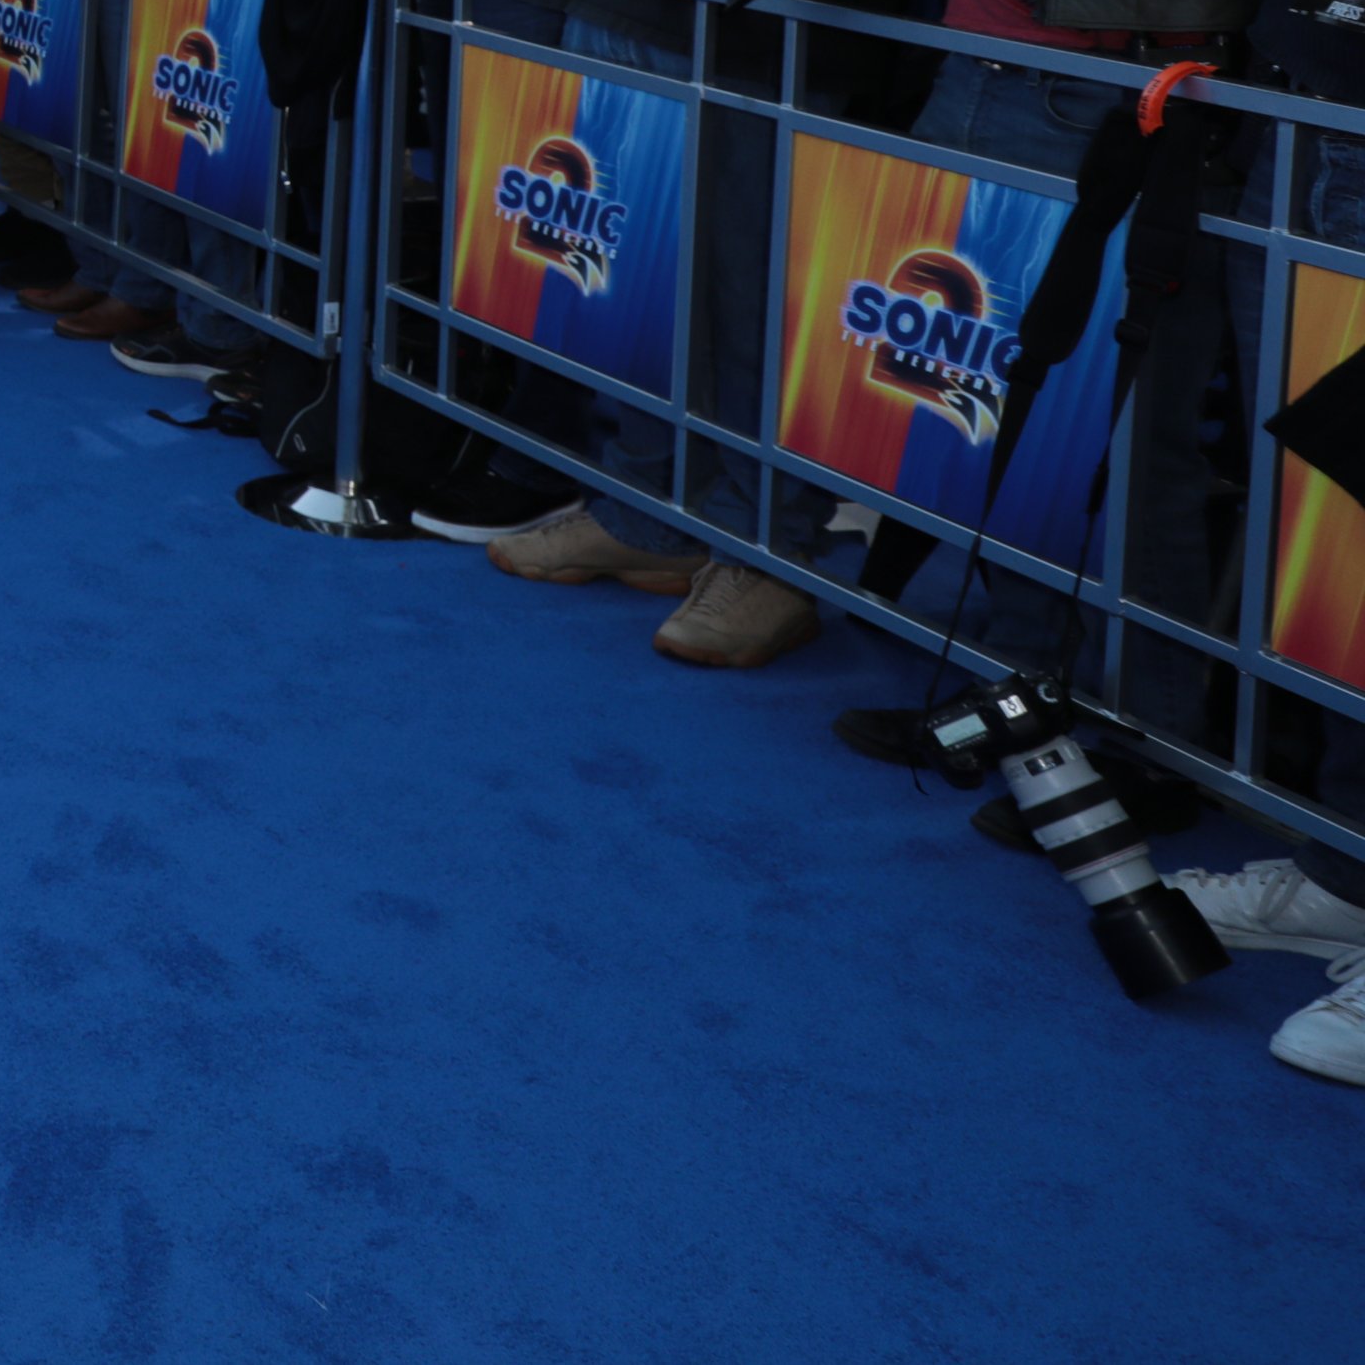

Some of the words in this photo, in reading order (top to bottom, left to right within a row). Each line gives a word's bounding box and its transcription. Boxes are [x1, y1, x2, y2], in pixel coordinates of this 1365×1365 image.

[1325, 0, 1365, 22] PRESS
[154, 57, 238, 113] SONIC
[498, 169, 627, 247] SONIC
[841, 330, 878, 354] THE
[894, 349, 1002, 397] HEDGEHO
